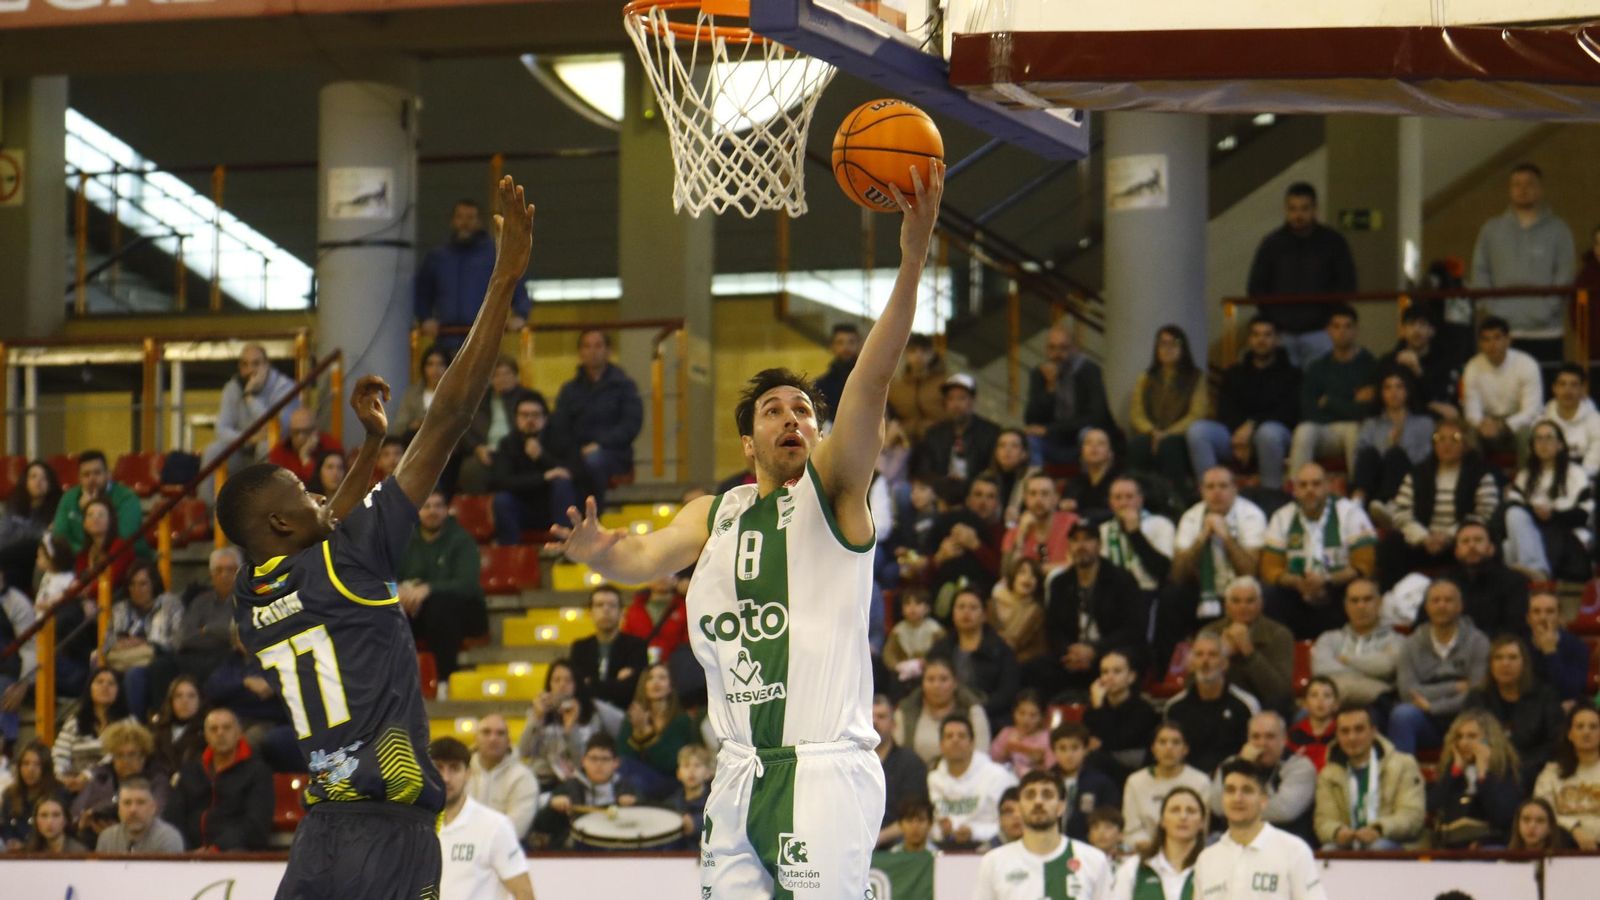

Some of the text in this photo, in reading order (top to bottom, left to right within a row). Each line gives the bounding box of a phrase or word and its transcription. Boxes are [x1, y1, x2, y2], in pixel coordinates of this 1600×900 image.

[737, 530, 763, 580] 8
[699, 601, 787, 642] coto
[256, 624, 351, 740] 77
[450, 843, 475, 862] CCB
[1251, 872, 1279, 892] CCB
